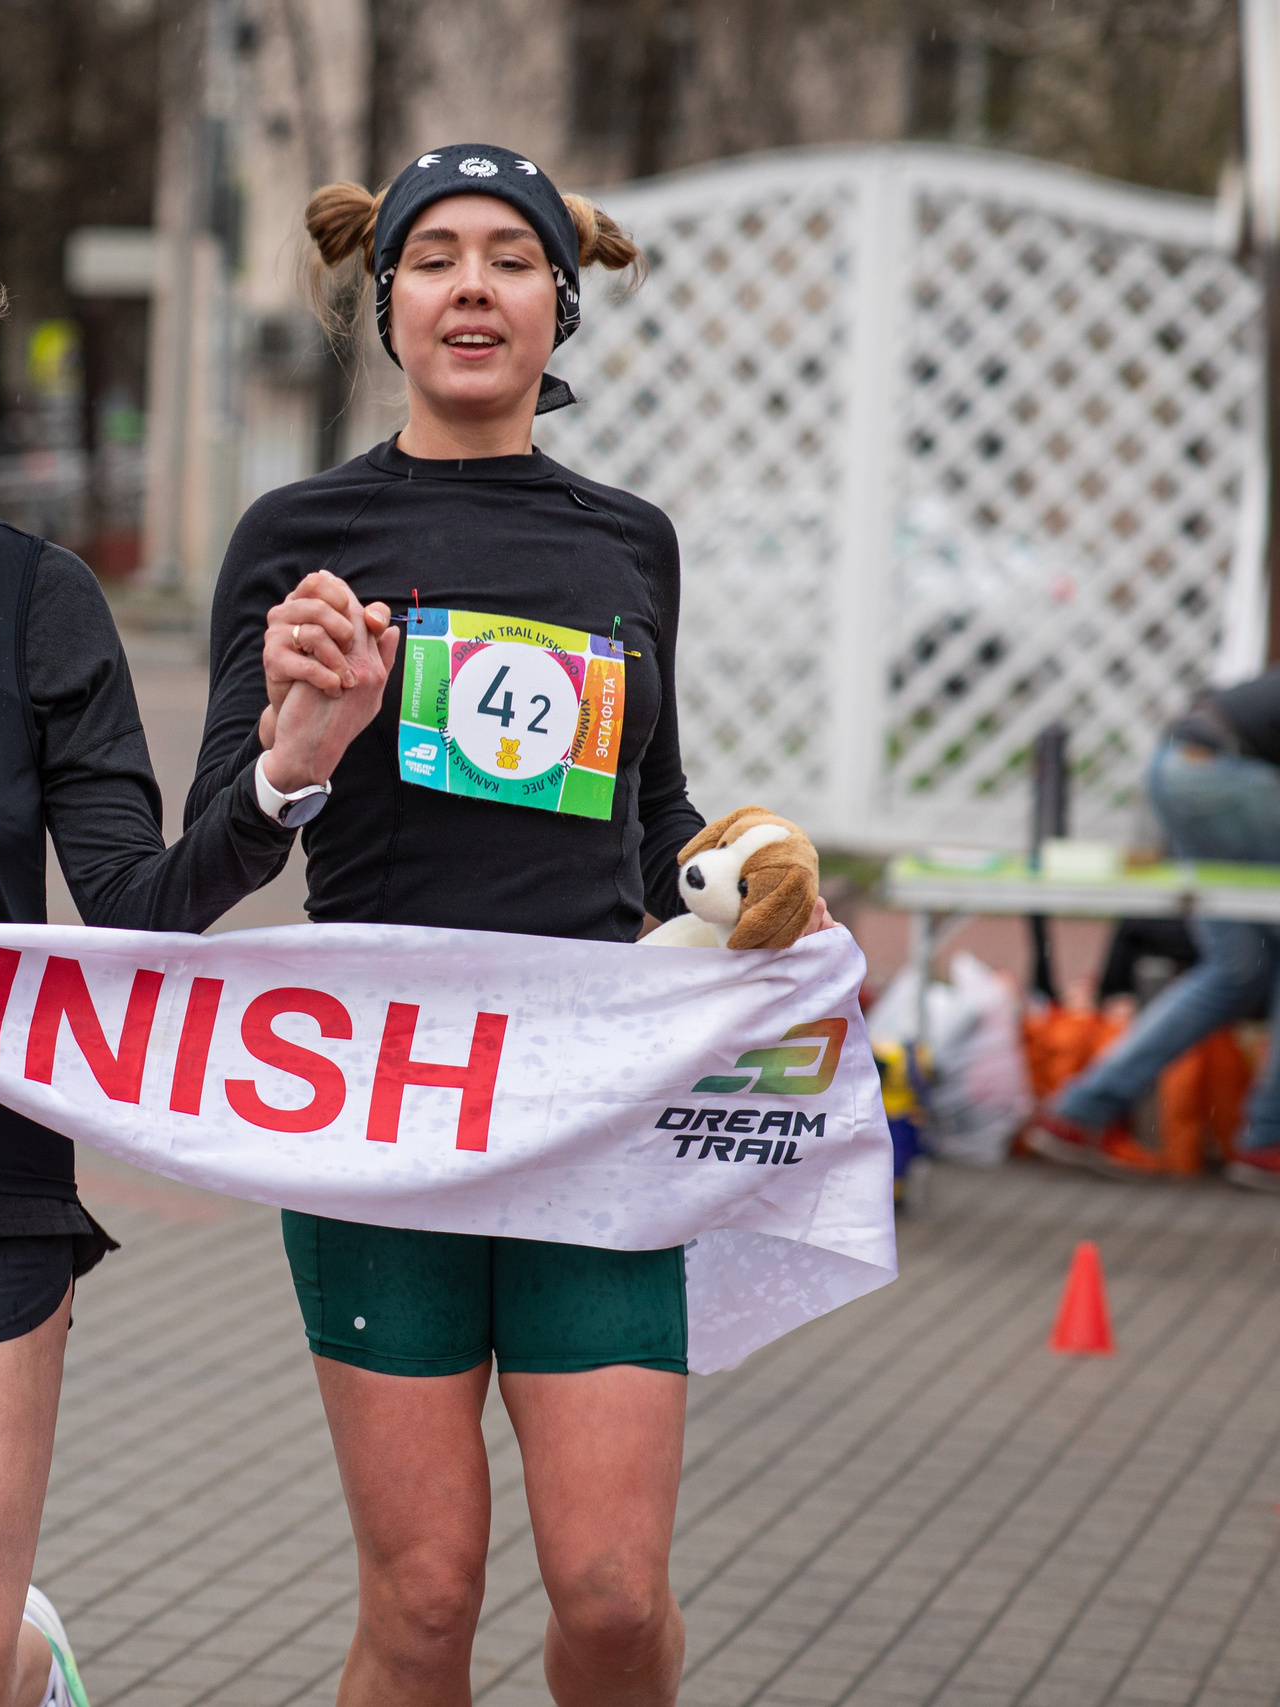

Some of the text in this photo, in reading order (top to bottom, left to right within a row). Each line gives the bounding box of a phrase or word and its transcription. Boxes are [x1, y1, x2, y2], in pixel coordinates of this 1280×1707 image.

[453, 626, 580, 676] DREAM TRAIL LYSKOVO
[436, 678, 451, 713] TRAIL
[595, 677, 616, 758] ЭСТАФЕТА
[453, 754, 500, 794] KANNAS
[522, 779, 545, 796] ЛЕС
[654, 1107, 827, 1138] DREAM
[672, 1134, 803, 1166] TRAIL
